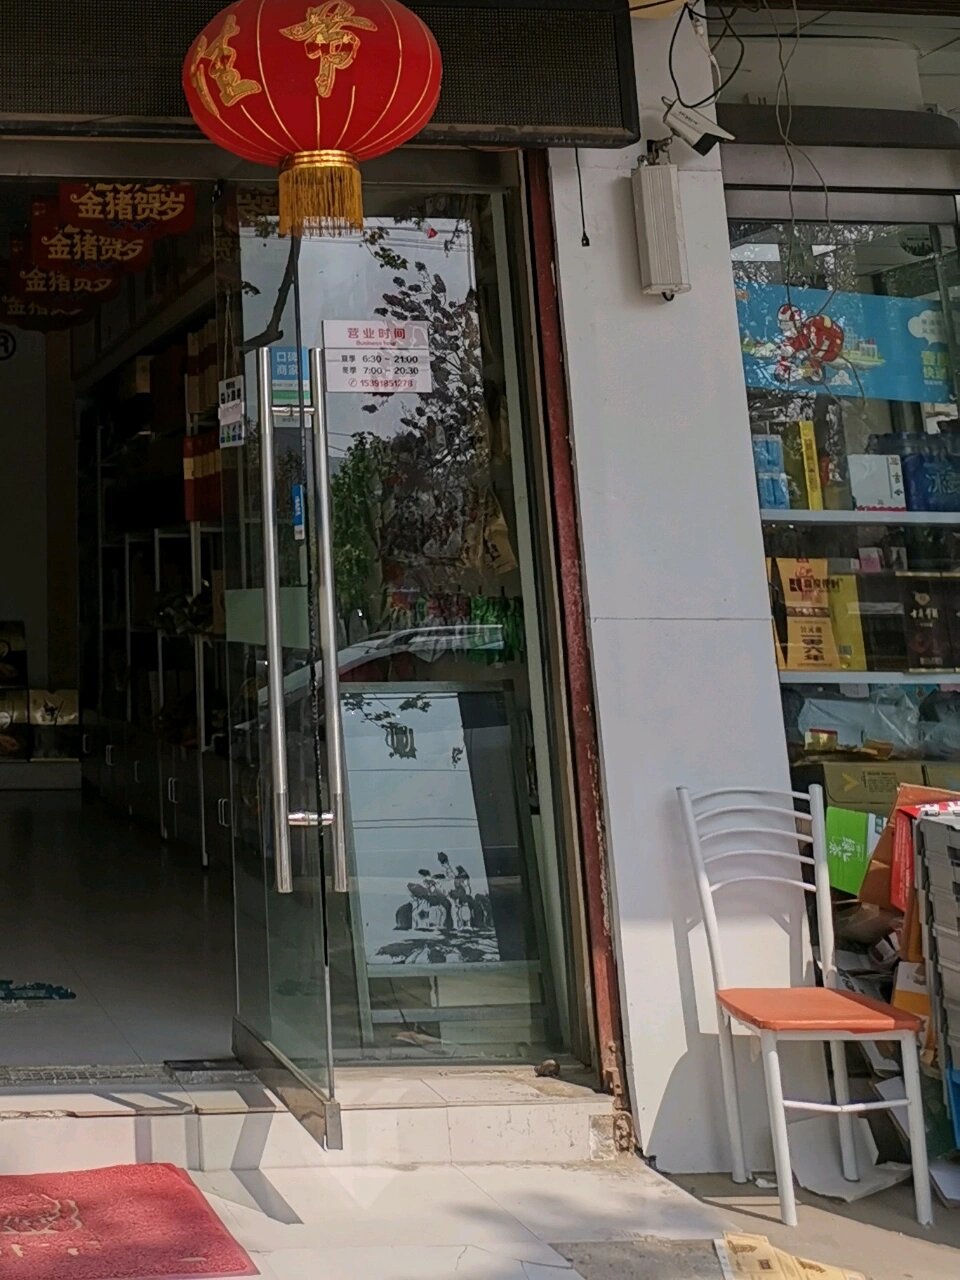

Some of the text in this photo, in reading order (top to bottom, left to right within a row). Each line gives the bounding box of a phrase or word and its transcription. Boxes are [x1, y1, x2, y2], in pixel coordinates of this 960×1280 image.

[70, 191, 185, 221] 金猪贺岁
[41, 233, 144, 261] 金猪贺岁
[347, 327, 406, 339] 营业时间
[362, 355, 382, 363] 6:30
[394, 355, 418, 363] 21:00
[363, 367, 382, 375] 7:00
[394, 367, 419, 375] 20:30
